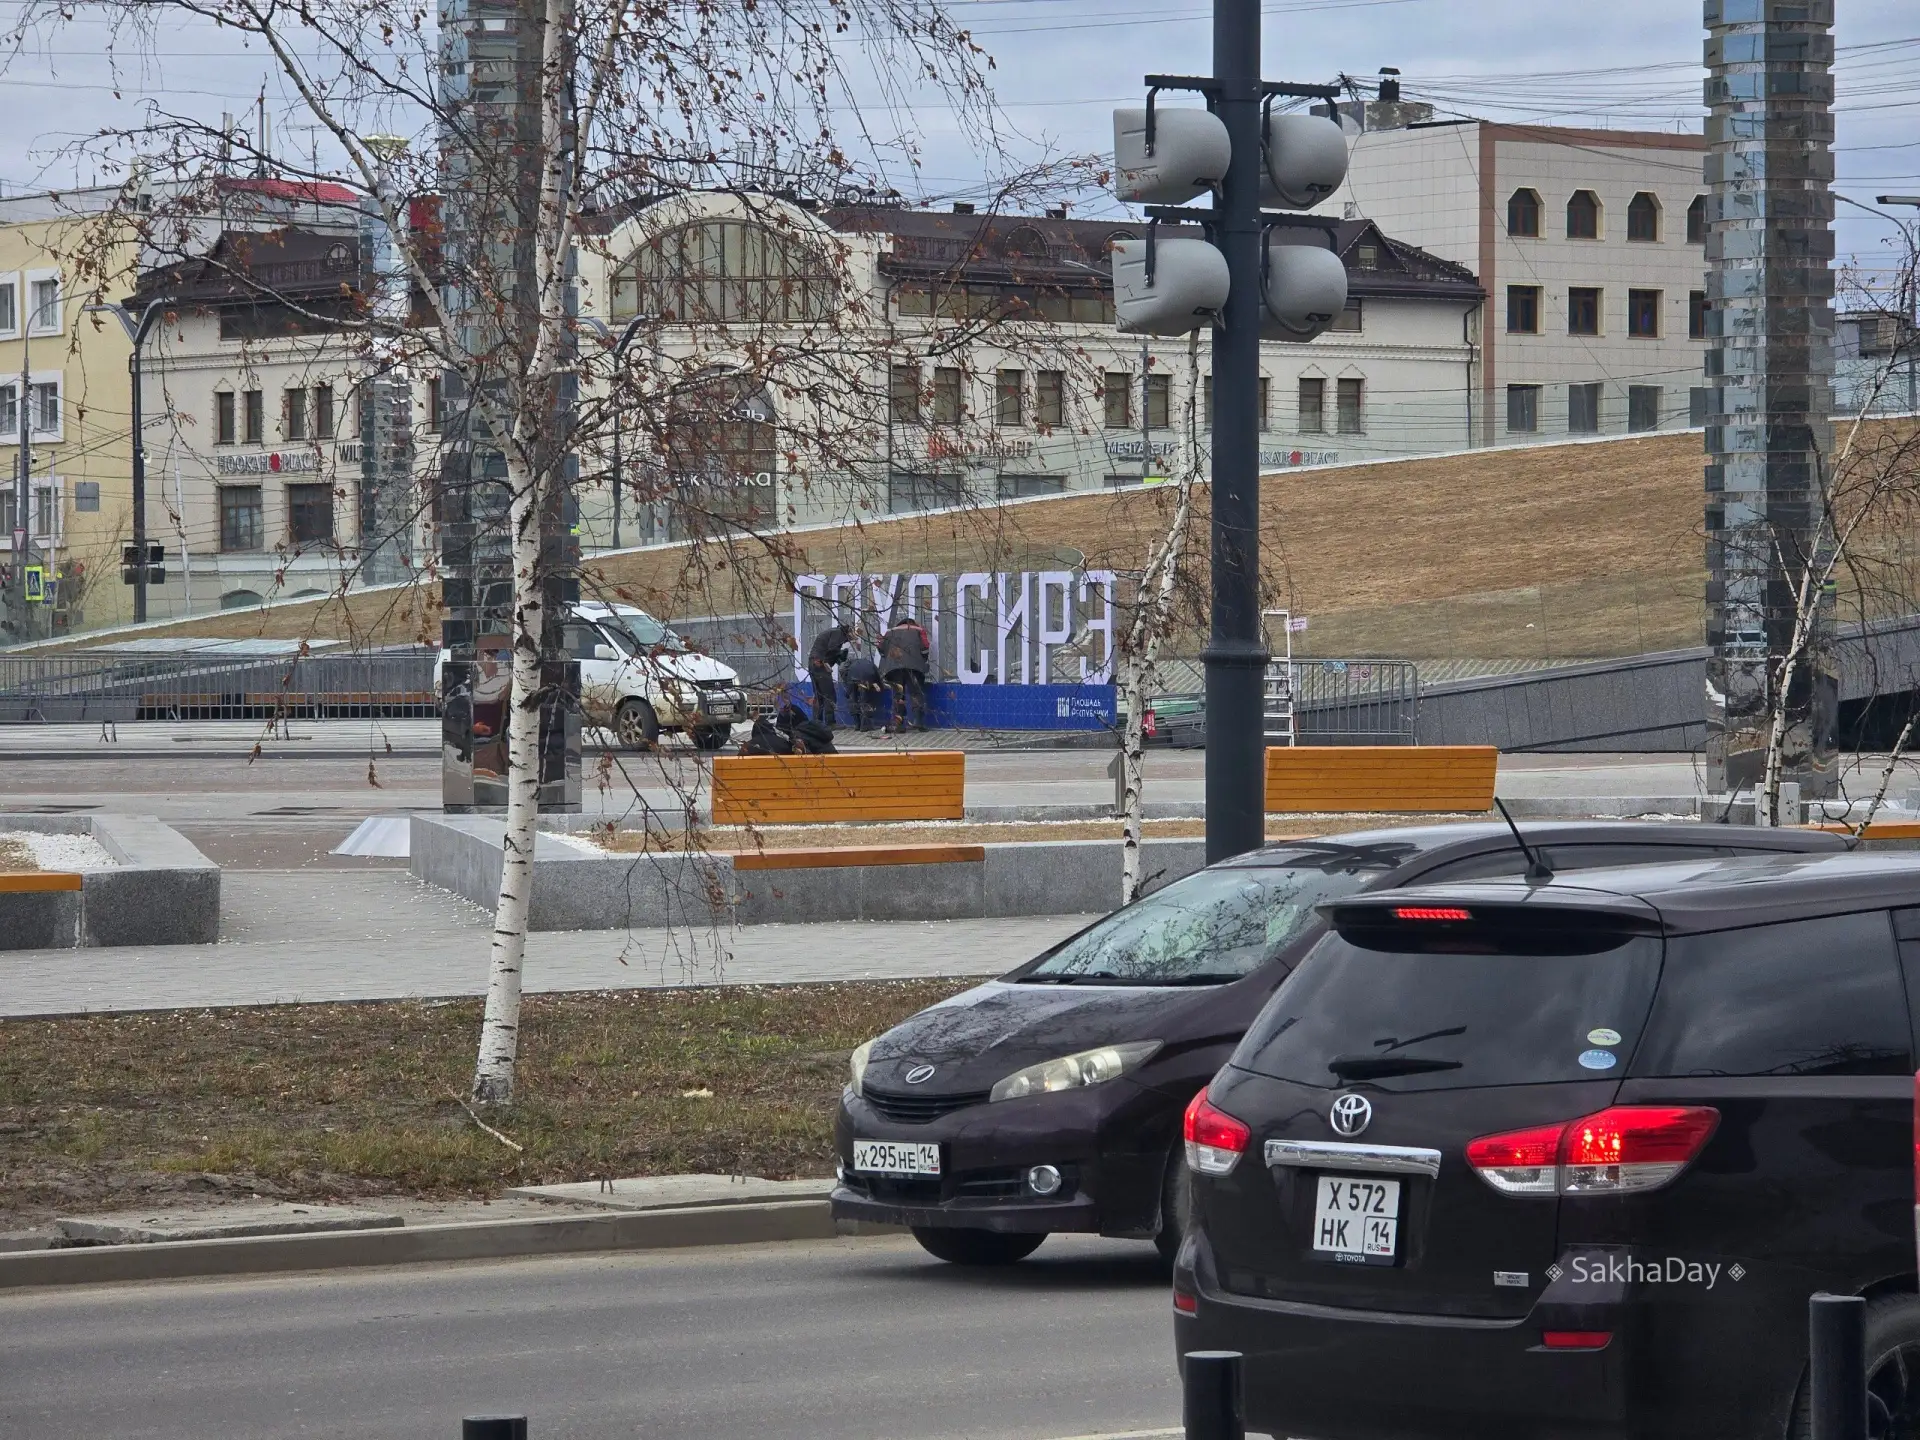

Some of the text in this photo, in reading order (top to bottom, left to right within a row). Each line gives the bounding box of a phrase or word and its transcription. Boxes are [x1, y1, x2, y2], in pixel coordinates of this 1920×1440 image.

[217, 452, 270, 473] HOOKAH
[957, 570, 1117, 685] СИРЭ
[919, 1146, 935, 1163] 14
[1348, 1183, 1386, 1213] 572
[1371, 1221, 1390, 1244] 14
[1367, 1243, 1381, 1252] RUS
[1343, 1254, 1366, 1263] TOYOTA
